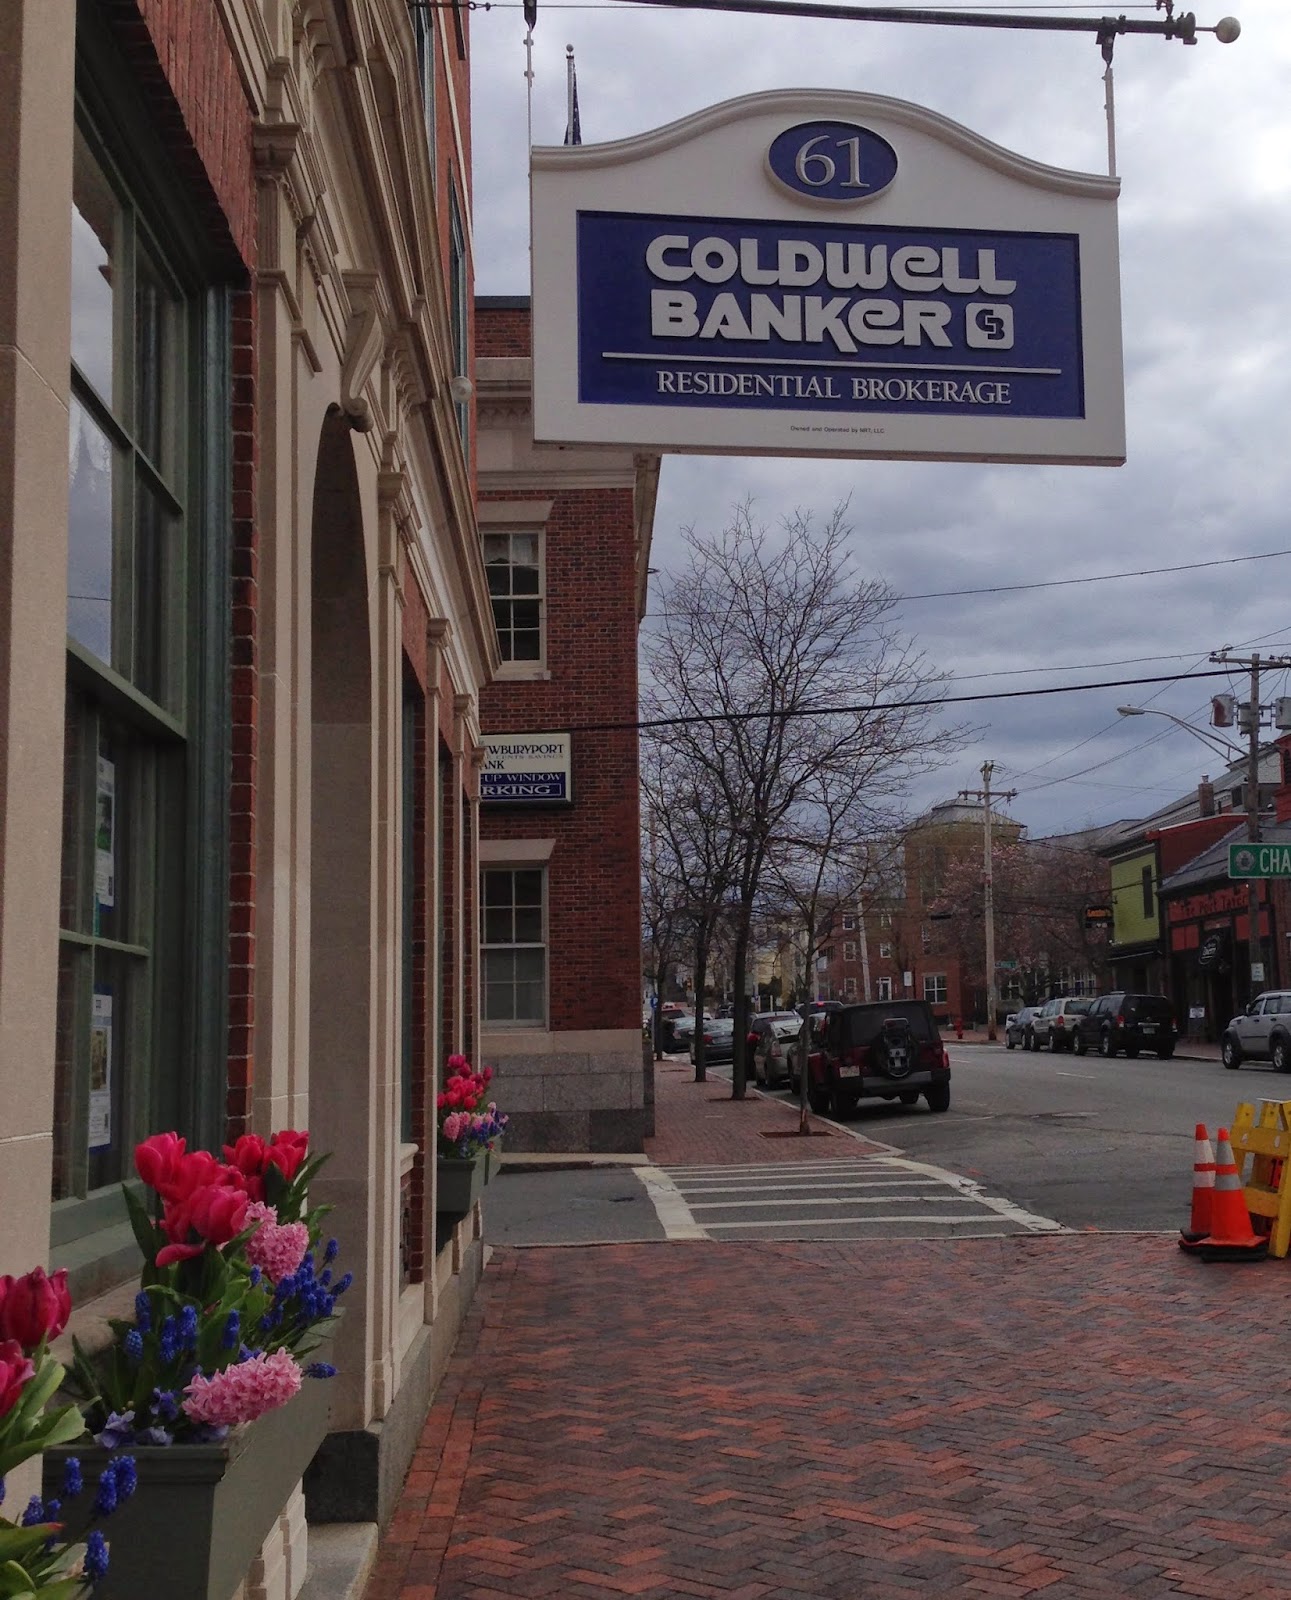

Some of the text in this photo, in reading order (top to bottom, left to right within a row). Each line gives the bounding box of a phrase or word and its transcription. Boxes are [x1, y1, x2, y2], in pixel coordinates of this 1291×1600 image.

[795, 134, 871, 188] 61
[645, 233, 1017, 294] COLDWELL
[650, 288, 953, 353] BANKER
[656, 370, 1012, 405] RESIDENTIAL BROKERAGE
[507, 773, 561, 781] WINDOW
